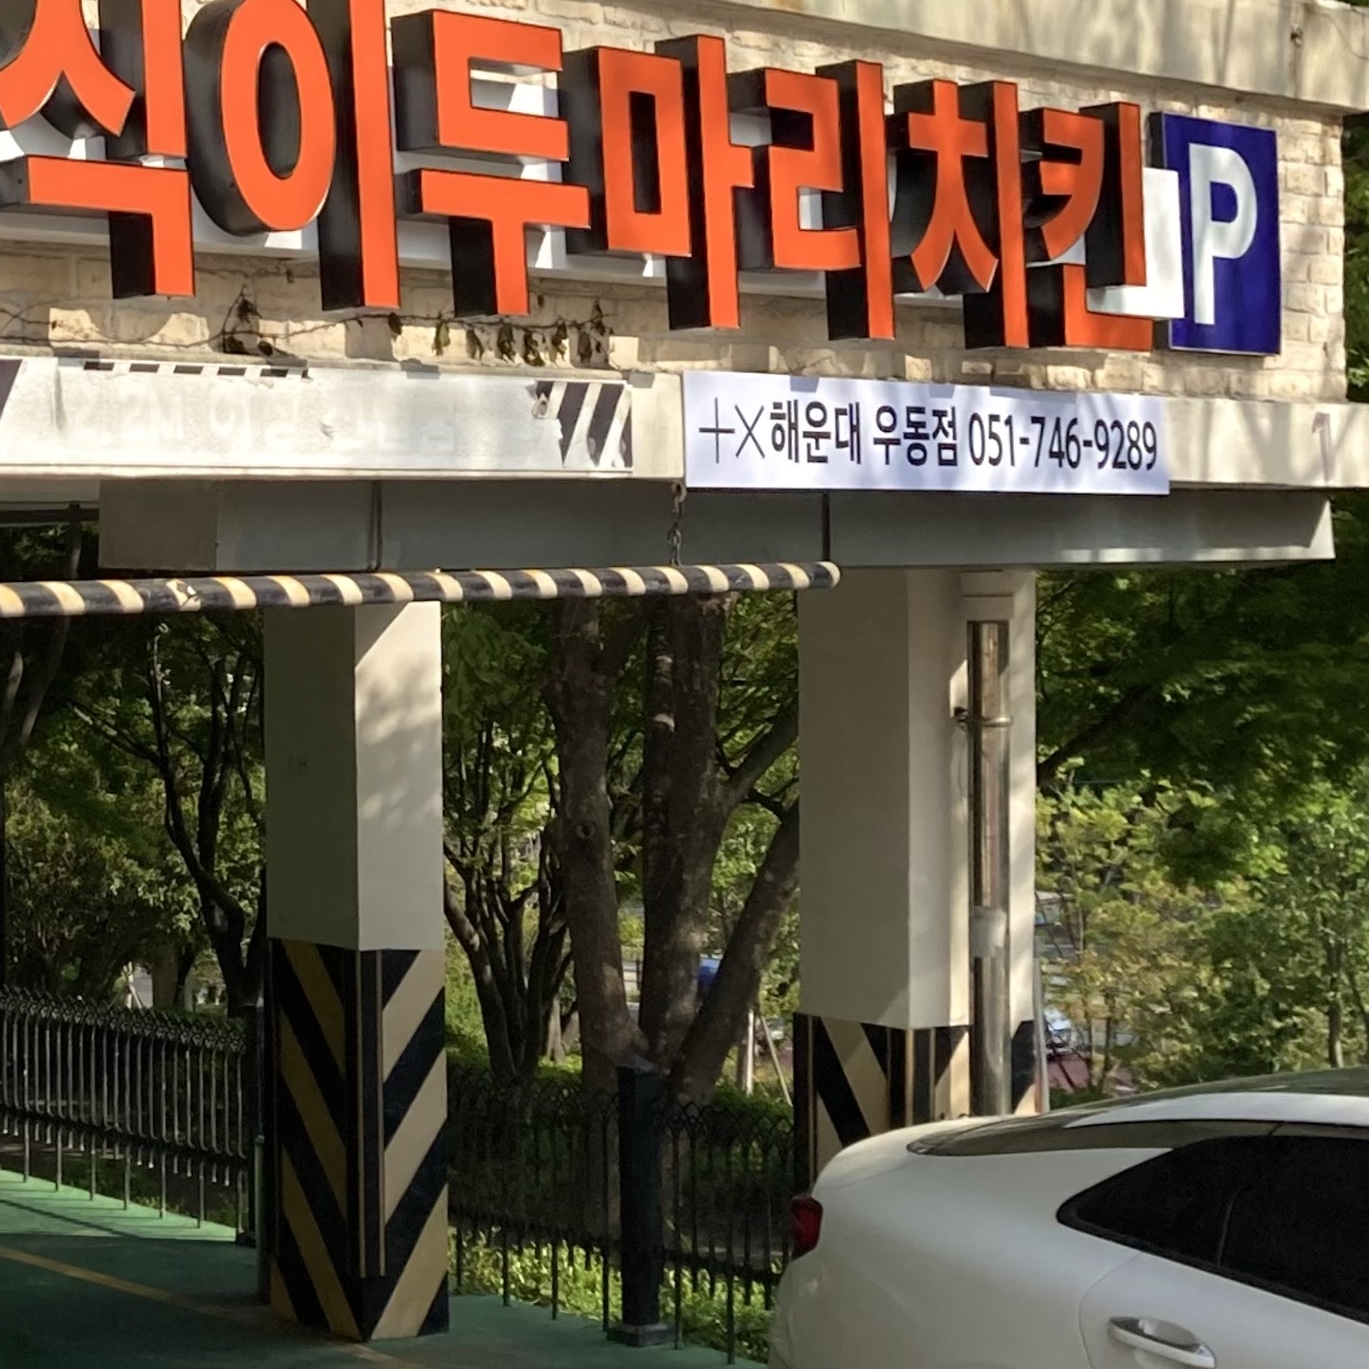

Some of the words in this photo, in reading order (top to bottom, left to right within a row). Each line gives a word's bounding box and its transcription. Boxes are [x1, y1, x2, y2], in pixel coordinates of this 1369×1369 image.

[1189, 142, 1258, 325] P
[770, 399, 861, 464] 해운대
[873, 406, 958, 467] 우동점
[968, 412, 1157, 471] 051-746-9289
